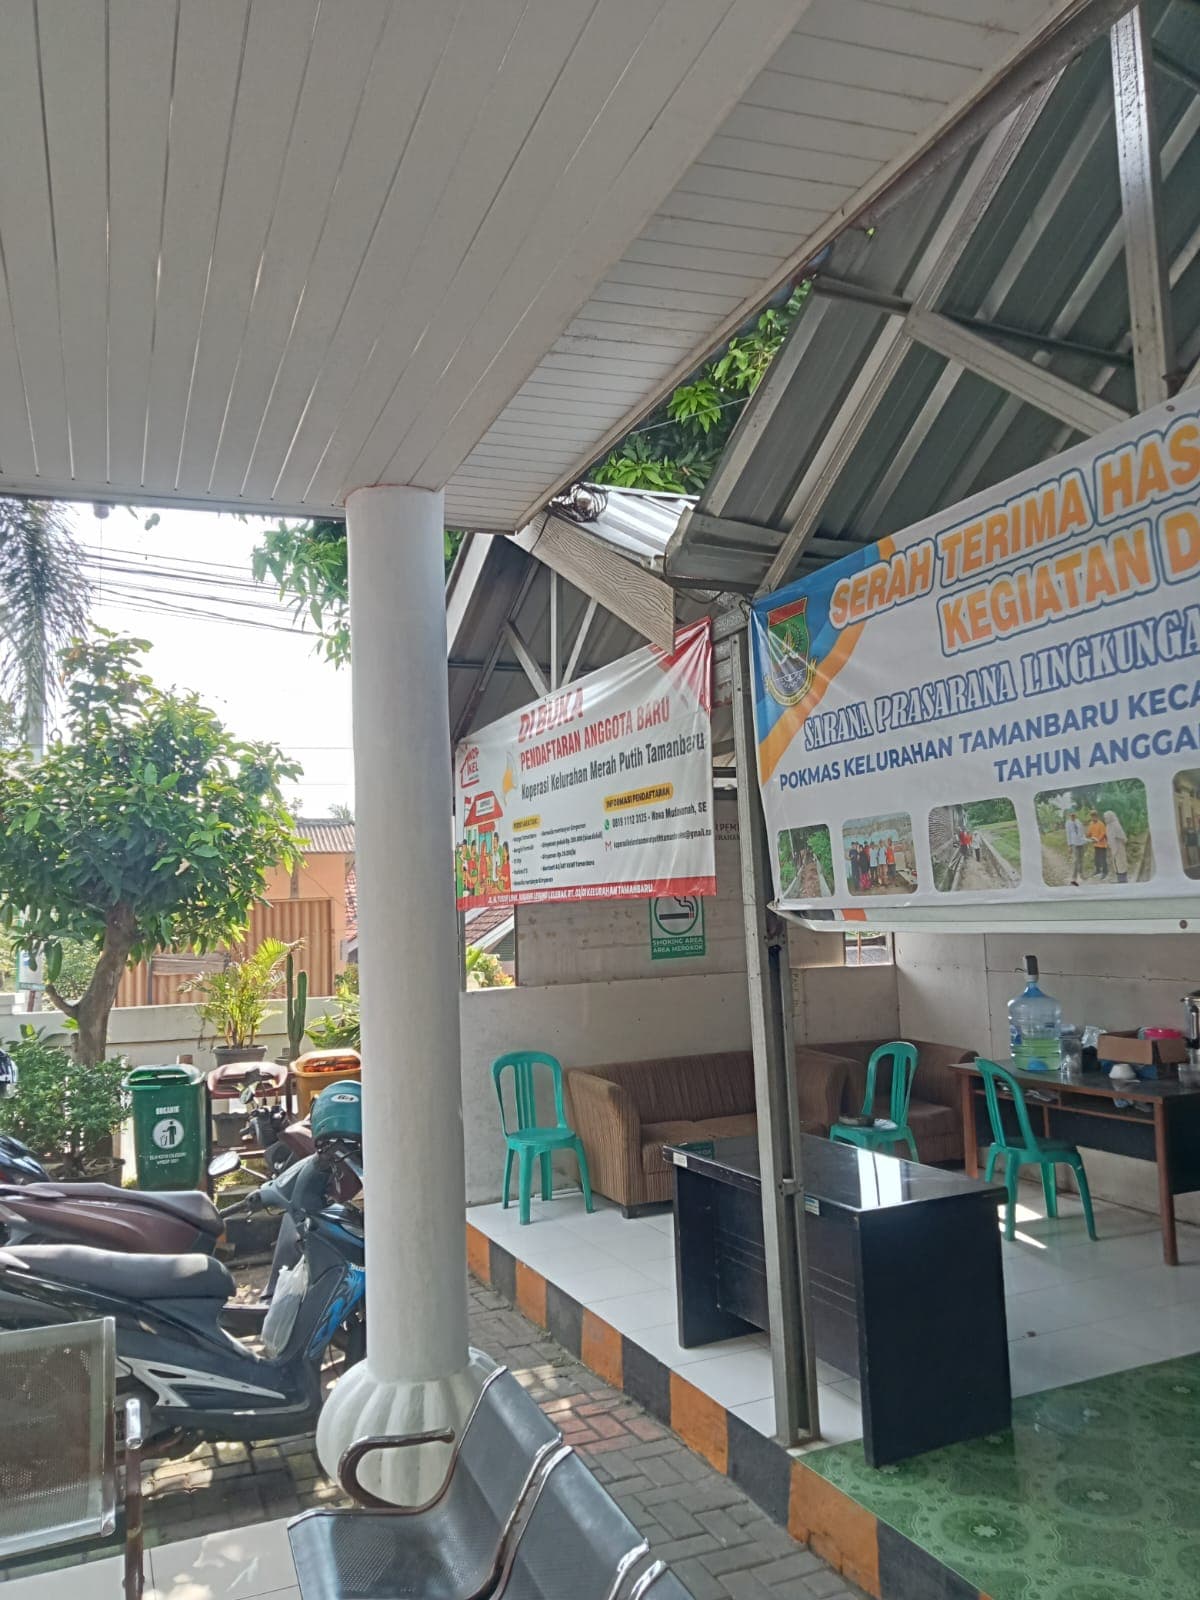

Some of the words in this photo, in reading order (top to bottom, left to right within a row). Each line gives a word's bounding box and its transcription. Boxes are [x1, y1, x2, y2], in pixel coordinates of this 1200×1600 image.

[830, 541, 933, 627] SERAH
[938, 474, 1087, 580] TERIMA
[942, 528, 1151, 648] KEGIATAN
[518, 687, 584, 743] DIBUKA
[520, 731, 581, 771] PENDAFTARAN
[584, 711, 633, 750] ANGGOTA
[637, 696, 670, 731] BARU
[804, 702, 873, 750] SARANA
[875, 661, 1018, 736] PRASARANA
[521, 777, 550, 802] Koperasi
[551, 767, 588, 792] Kelurahan
[590, 750, 617, 780] Merah
[619, 746, 643, 772] Putih
[645, 733, 705, 763] Tamanbaru
[779, 760, 840, 791] POKMAS
[843, 741, 954, 780] KELURAHAN
[958, 698, 1119, 754] TAMANBARU
[994, 745, 1081, 784] TAHUN
[632, 787, 670, 804] PENDAFTARAN
[698, 801, 707, 813] SE
[652, 937, 684, 947] SMOKING
[685, 937, 703, 945] AREA
[653, 946, 671, 954] AREA
[672, 944, 704, 952] MEROKOK
